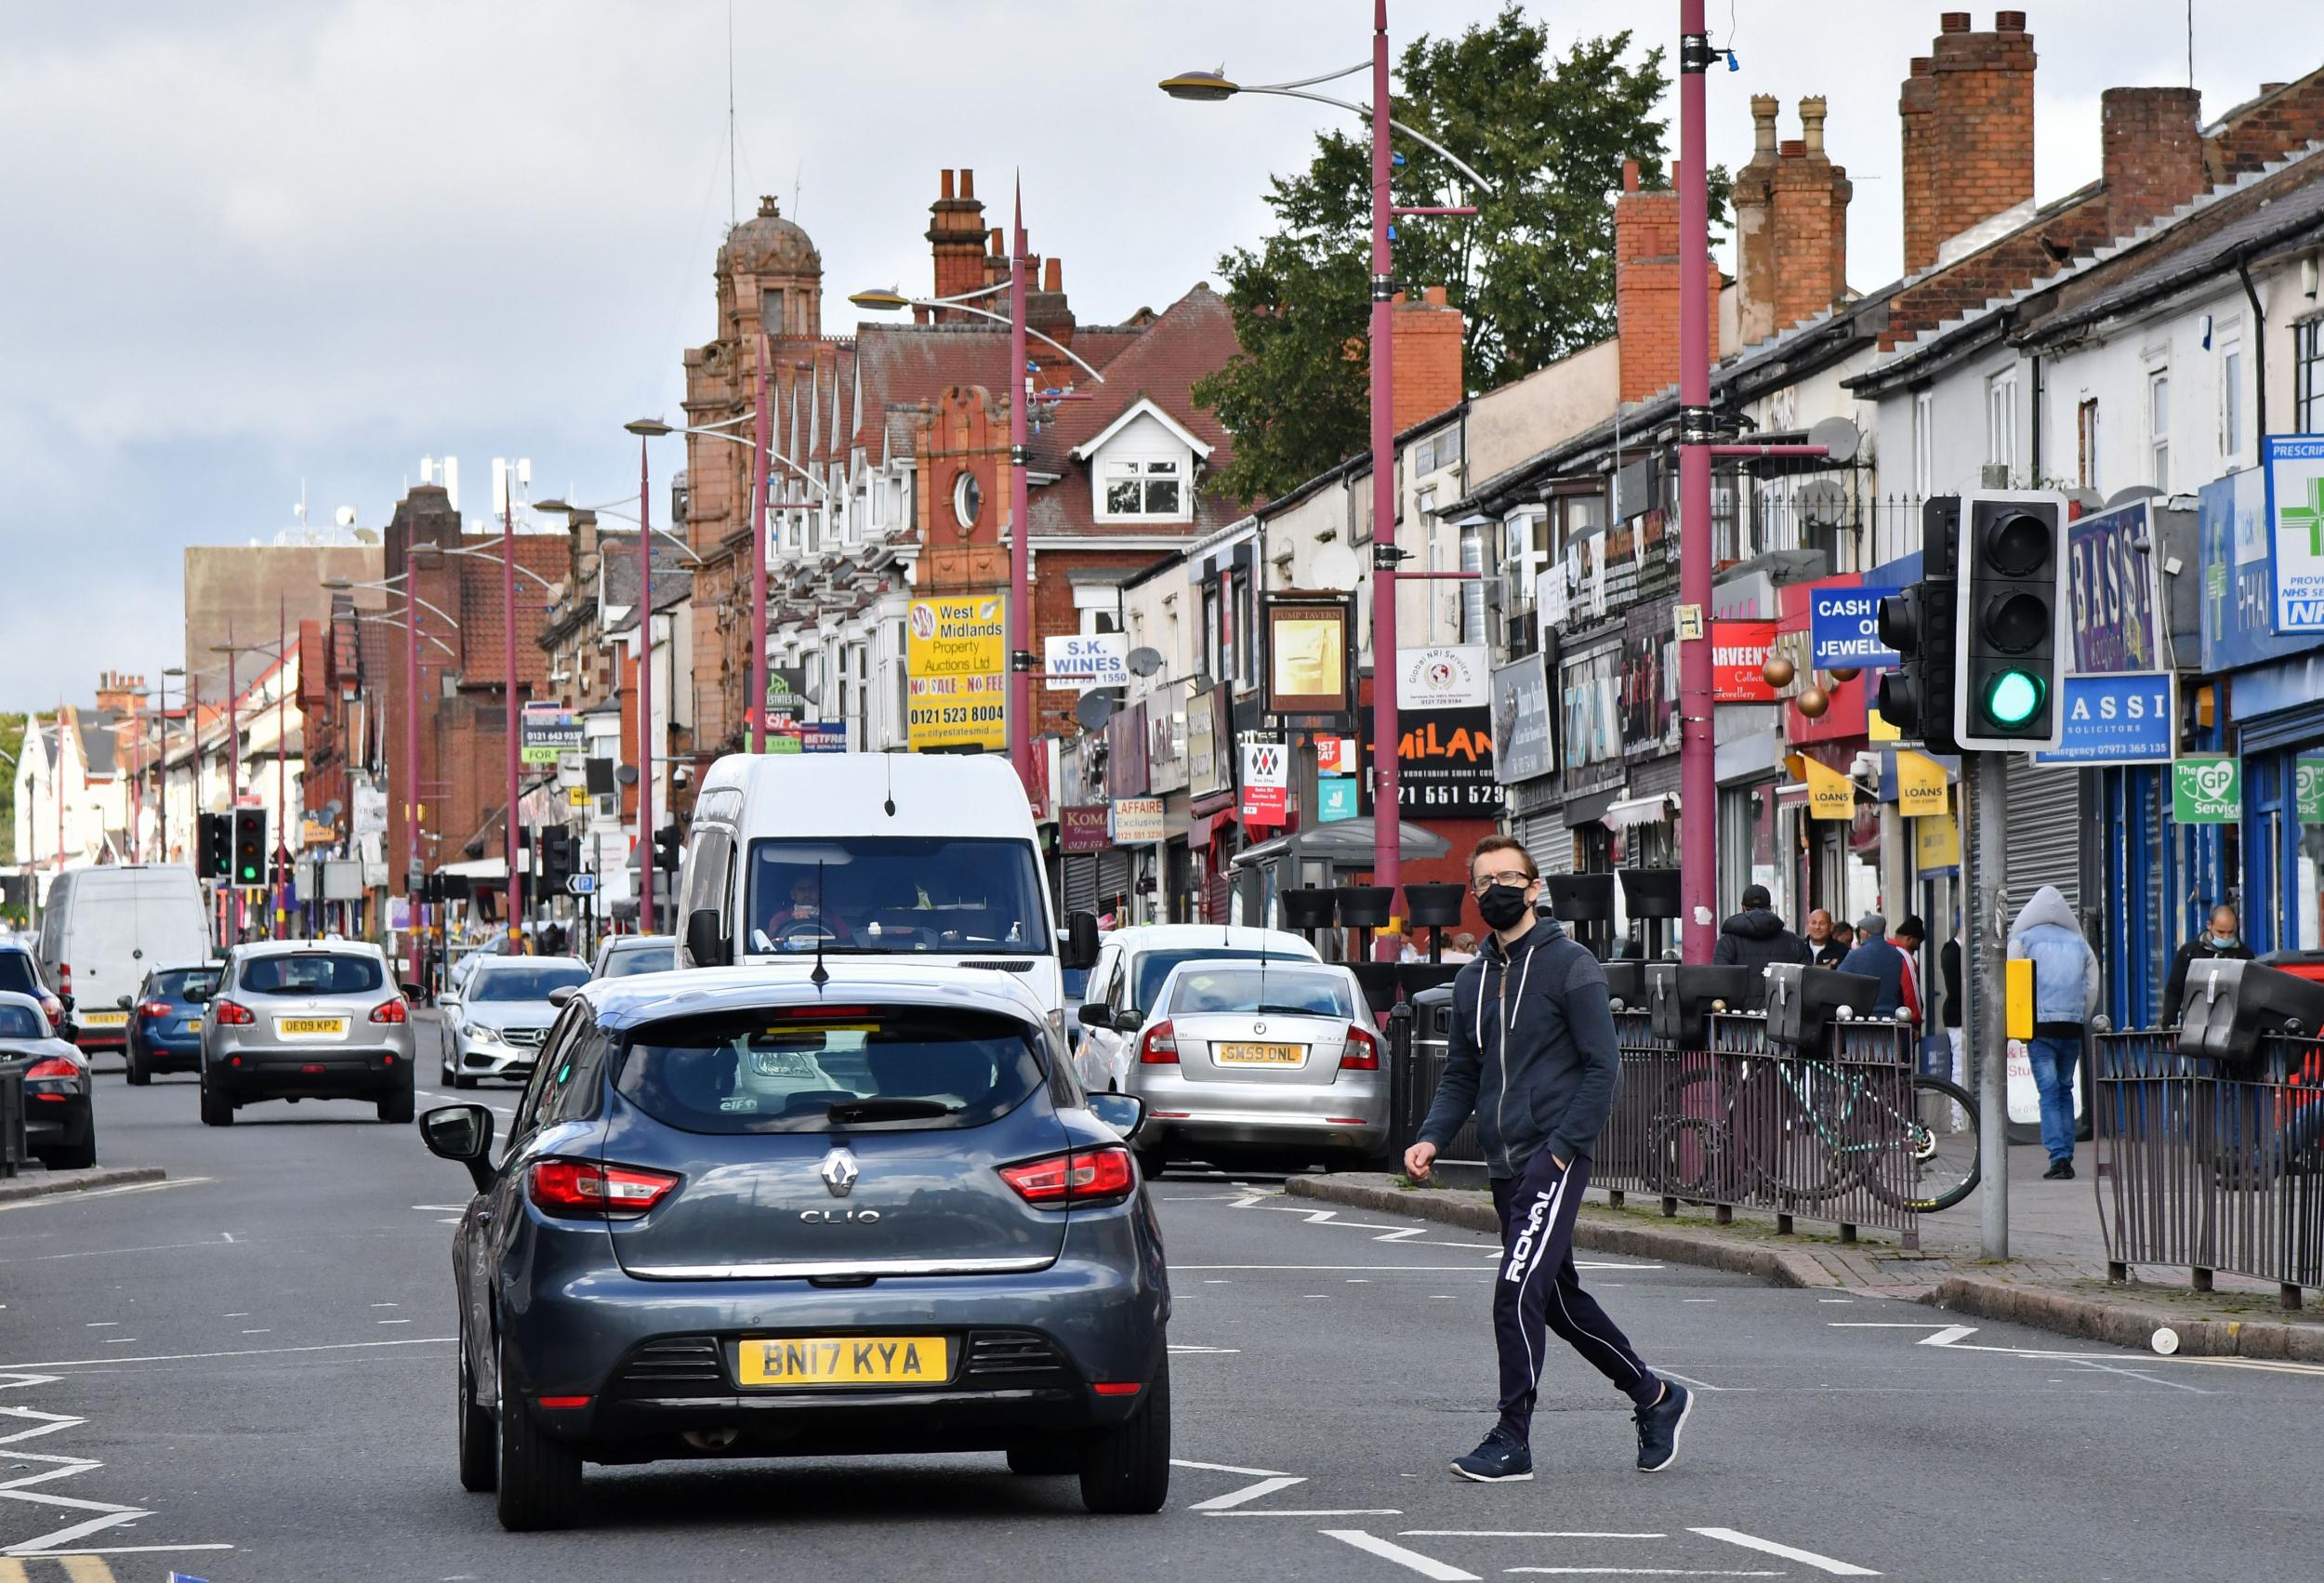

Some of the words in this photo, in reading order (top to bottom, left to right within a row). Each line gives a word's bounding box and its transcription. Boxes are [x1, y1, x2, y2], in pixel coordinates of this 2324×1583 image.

[2281, 587, 2307, 598] NHS
[940, 604, 973, 620] West
[1304, 610, 1340, 619] TAVERN
[1818, 600, 1870, 616] CASH
[940, 622, 1002, 638] Midlands
[932, 640, 980, 655] Property
[1067, 640, 1107, 655] S.K.
[1816, 639, 1901, 656] JEWELL
[924, 659, 970, 671] Auctions
[973, 656, 990, 669] Ltd
[1052, 656, 1121, 672] WINES
[1103, 673, 1127, 683] 1550
[910, 679, 926, 695] NO
[931, 677, 957, 694] SALE
[967, 676, 983, 693] NO
[985, 675, 1004, 692] FEE
[911, 709, 939, 724] 0121
[944, 707, 967, 723] 523
[971, 706, 1004, 721] 8004
[2067, 724, 2141, 734] SOLICITORS
[527, 731, 547, 741] 0121
[548, 731, 562, 741] 643
[529, 750, 551, 759] FOR
[2097, 745, 2126, 755] 07973
[2128, 745, 2146, 754] 365
[2149, 743, 2167, 753] 135
[2177, 765, 2197, 775] The
[2202, 771, 2229, 789] GP
[1425, 785, 1459, 804] 551
[1815, 793, 1849, 802] LOANS
[1905, 787, 1942, 798] LOANS
[1116, 800, 1163, 814] LAFFAIRE
[1116, 818, 1161, 828] Exclusive
[1068, 841, 1087, 850] 0121
[582, 877, 590, 890] P
[316, 1020, 338, 1031] KPZ
[1268, 1047, 1296, 1062] ONL
[2008, 1047, 2016, 1058] &
[720, 1100, 744, 1110] elf
[800, 1210, 880, 1223] CLIO
[1505, 1181, 1558, 1283] ROYAL
[762, 1343, 840, 1376] BN17
[852, 1342, 922, 1375] KYA
